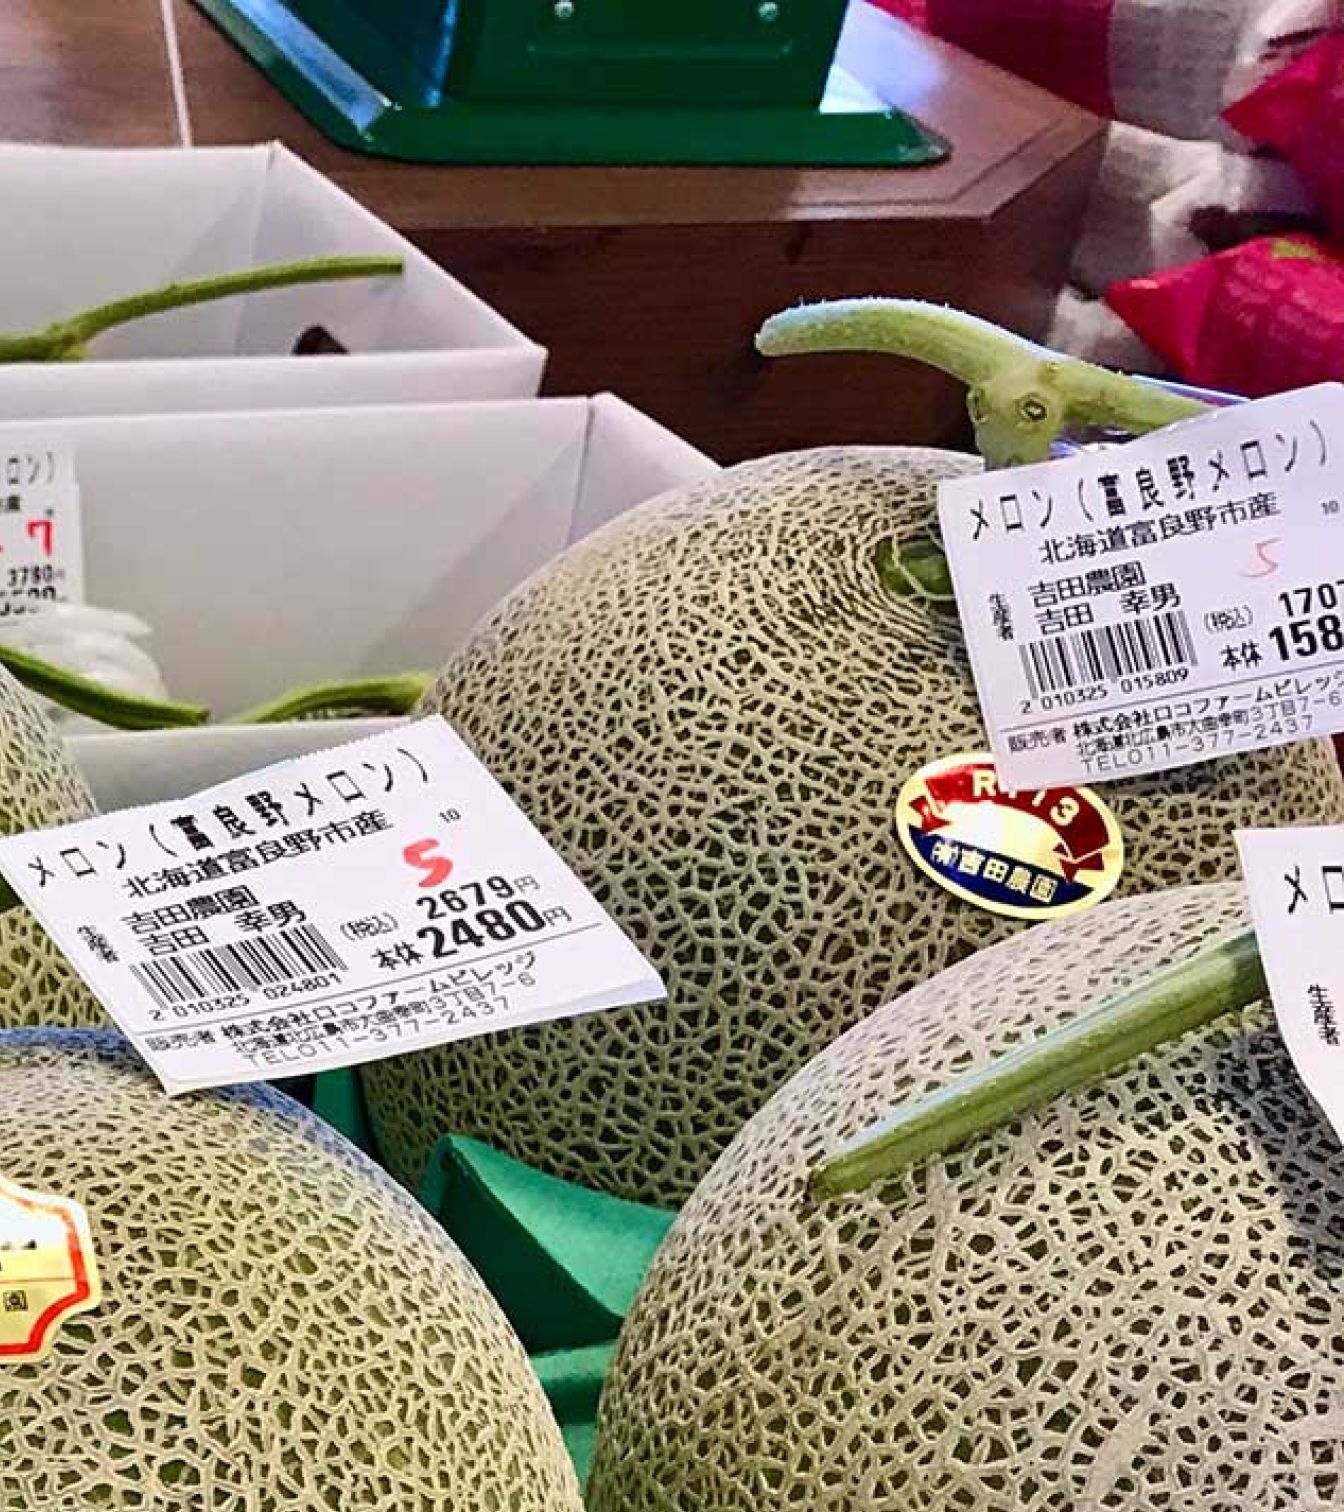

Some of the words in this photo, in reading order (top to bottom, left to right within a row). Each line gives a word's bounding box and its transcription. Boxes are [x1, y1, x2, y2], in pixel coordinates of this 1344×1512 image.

[1027, 560, 1147, 609] 吉田農園
[1121, 668, 1190, 694] 015809
[439, 808, 462, 824] 10
[972, 769, 1080, 827] R3
[123, 808, 394, 899] 北海道富良野市産
[121, 883, 261, 936] 吉田農園
[371, 940, 425, 971] 本体
[416, 899, 574, 960] 2480円
[172, 992, 250, 1019] 010325
[262, 972, 342, 1001] 024801
